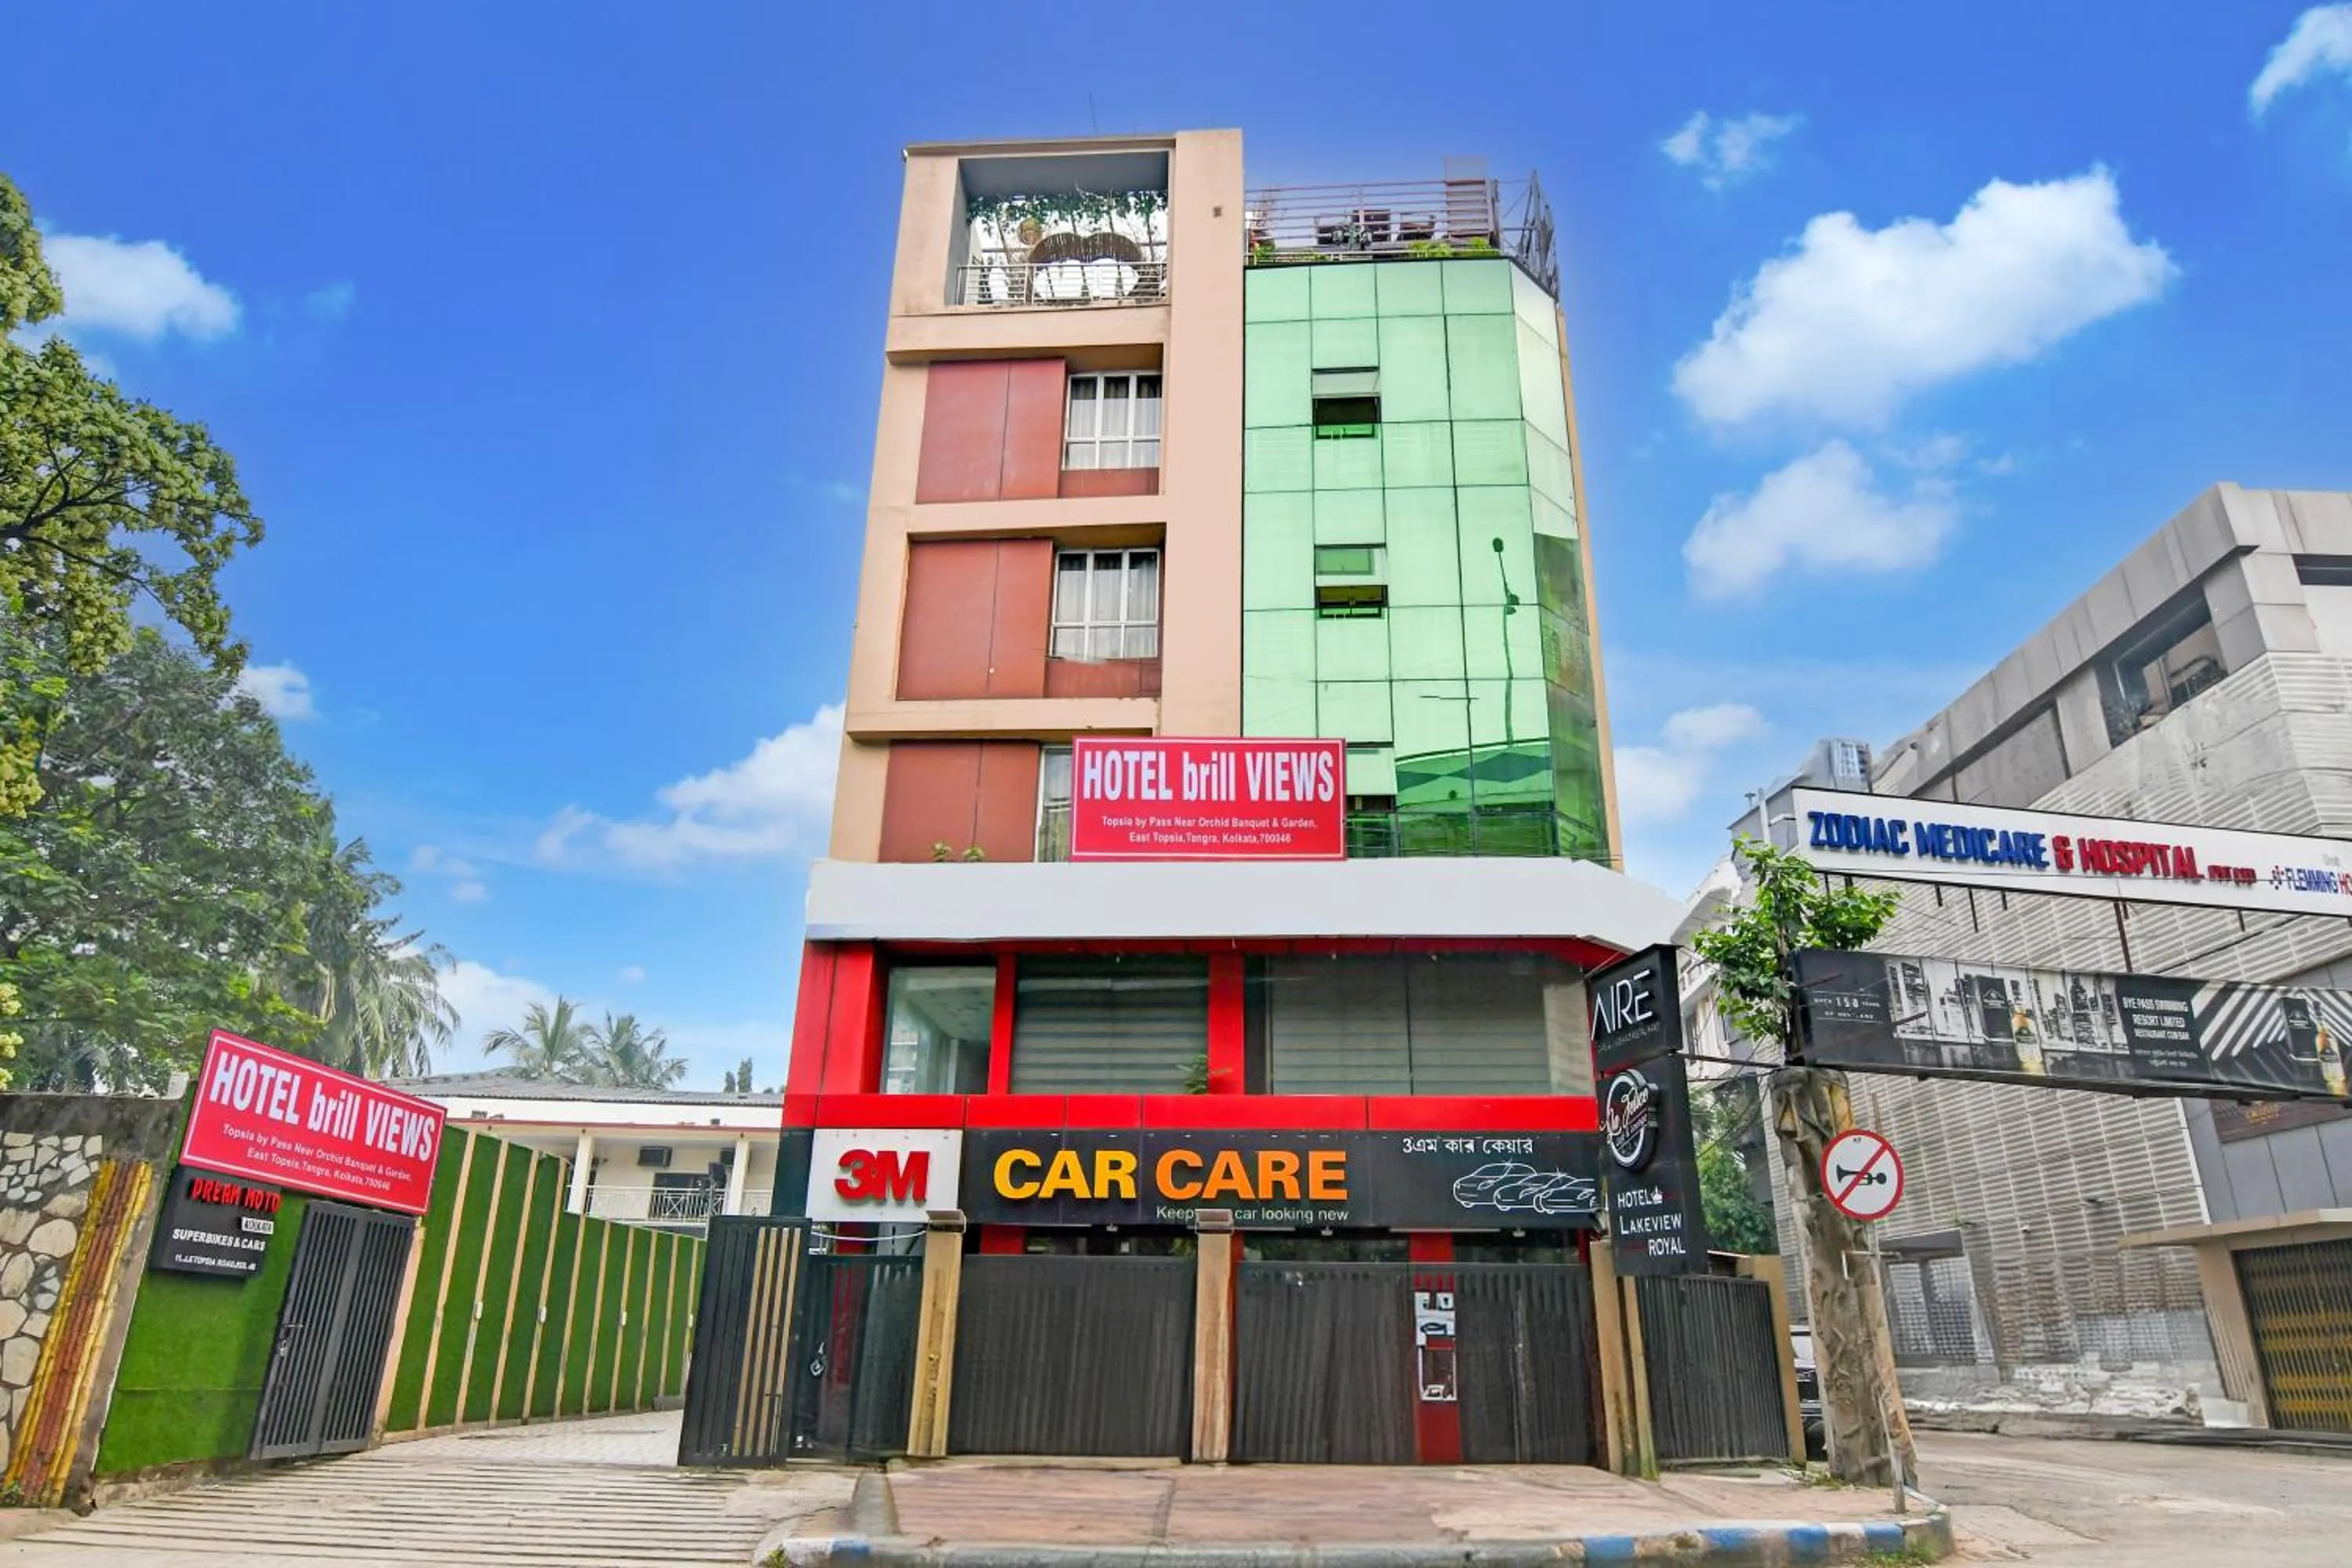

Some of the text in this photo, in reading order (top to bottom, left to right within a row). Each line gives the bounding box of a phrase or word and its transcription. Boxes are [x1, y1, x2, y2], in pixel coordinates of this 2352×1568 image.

[1082, 750, 1334, 803] HOTEL brill VIEWS
[1102, 816, 1133, 829] Topsia
[1135, 816, 1147, 829] by
[1150, 816, 1171, 828] Pass
[1175, 817, 1196, 827] Near
[1199, 817, 1230, 828] Orchid
[1129, 833, 1150, 843] East
[1807, 810, 1910, 855] ZODIAC
[1914, 821, 2050, 869] MEDICARE
[2052, 835, 2074, 871] &
[2078, 837, 2205, 881] HOSPITAL
[2285, 867, 2339, 894] FLEMMING
[1591, 969, 1653, 1041] AIRE
[209, 1051, 436, 1163] HOTEL brill VIEWS
[223, 1123, 256, 1142] Topsia
[256, 1132, 267, 1146] by
[270, 1134, 293, 1152] Pass
[294, 1142, 315, 1156] Near
[316, 1149, 343, 1165] Orchid
[246, 1147, 270, 1162] East
[833, 1149, 1348, 1203] 3M CAR CARE
[191, 1178, 283, 1214] DREAM MOTO
[1617, 1188, 1652, 1208] HOTEL
[1156, 1206, 1348, 1223] Keep car looking new
[1619, 1213, 1682, 1235] LAKEVIEW
[1648, 1236, 1686, 1257] ROYAL
